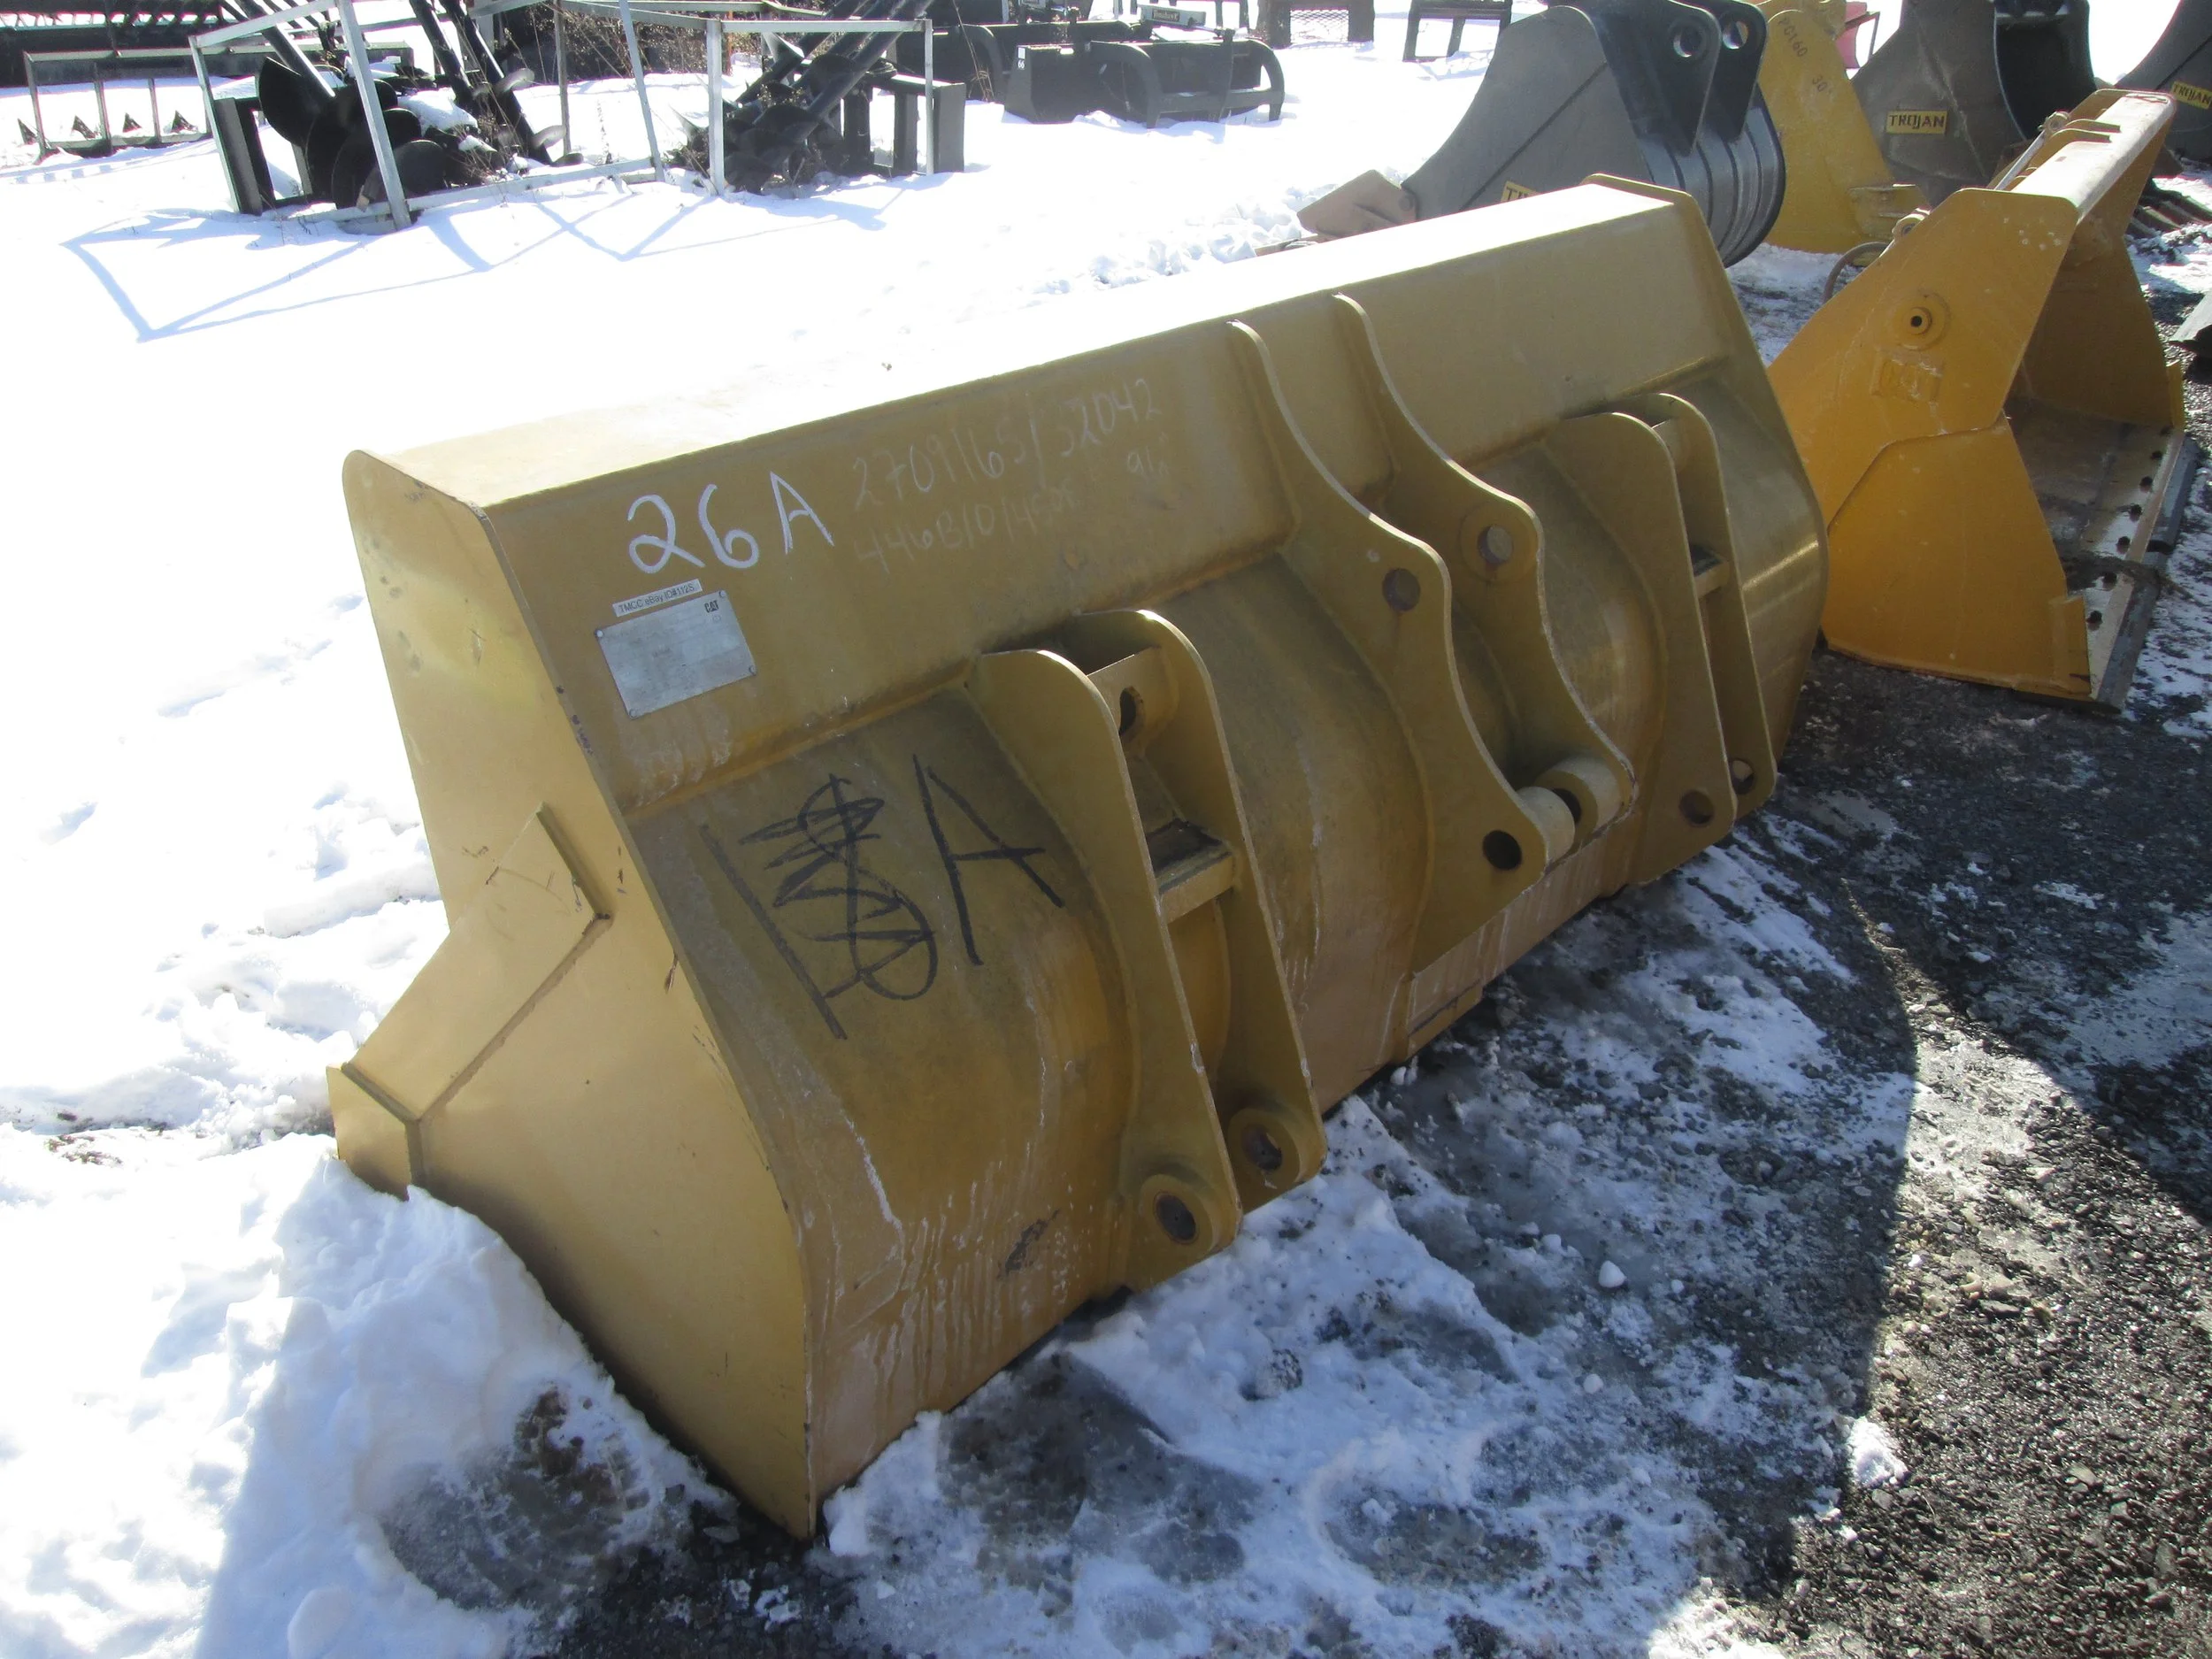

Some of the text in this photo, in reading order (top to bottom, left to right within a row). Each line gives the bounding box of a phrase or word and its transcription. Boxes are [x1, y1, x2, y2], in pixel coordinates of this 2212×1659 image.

[1889, 114, 1945, 129] TROJAN
[645, 594, 664, 605] eBay
[704, 600, 719, 613] CAT
